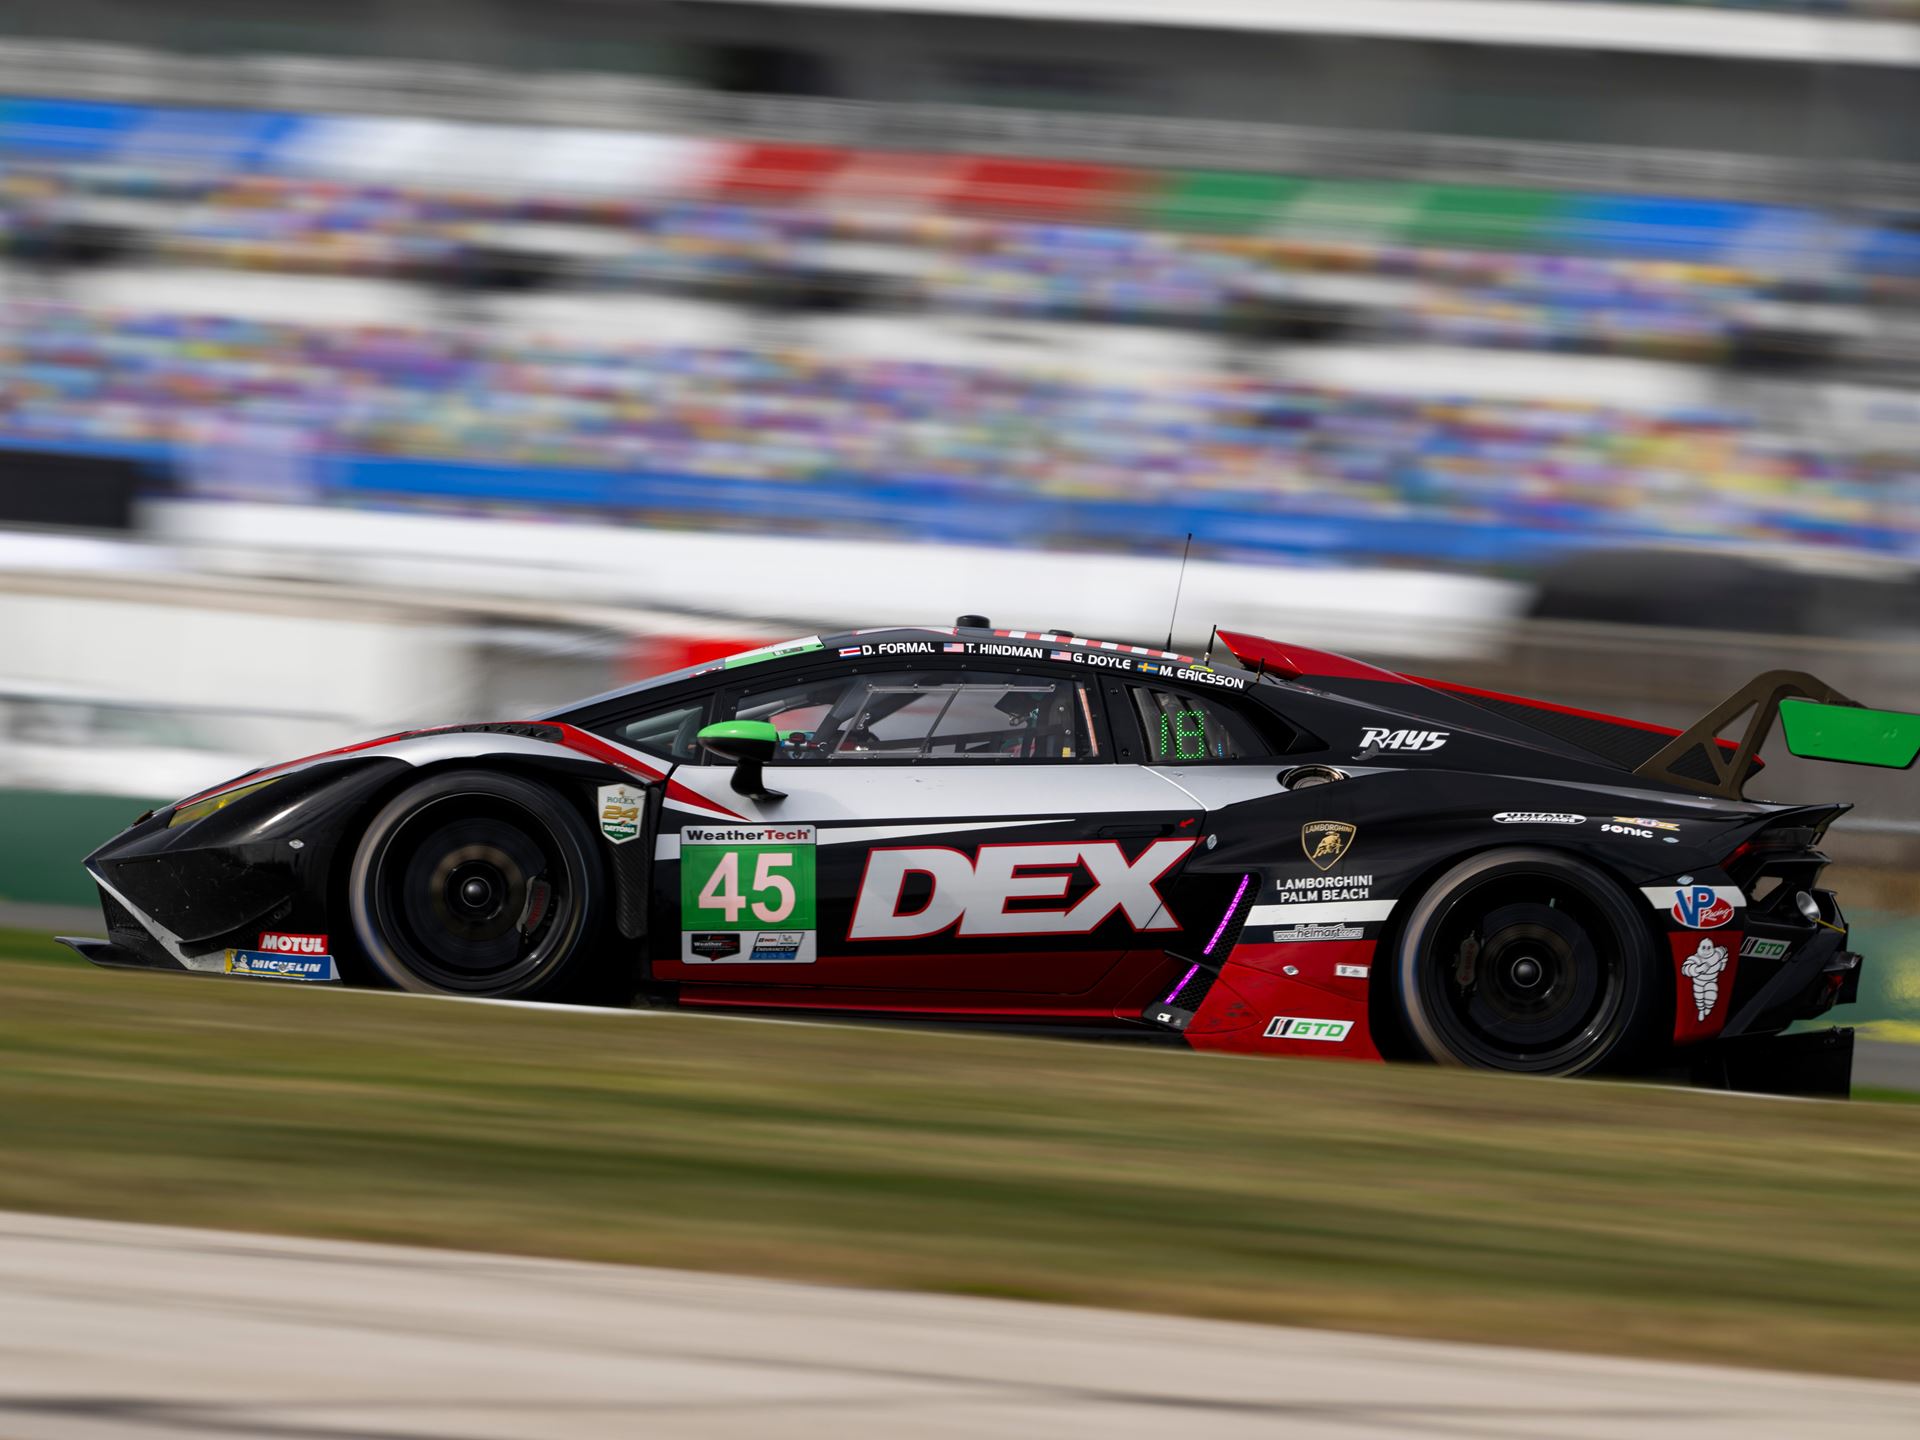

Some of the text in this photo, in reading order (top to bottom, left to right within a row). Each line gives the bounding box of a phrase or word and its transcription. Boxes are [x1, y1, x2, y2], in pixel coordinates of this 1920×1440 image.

[862, 642, 936, 656] D. FORMAL
[966, 643, 1043, 659] T. HINDMAN
[1072, 652, 1132, 670] G. DOYLE
[1159, 665, 1245, 689] M. ERICSSON
[1358, 726, 1451, 751] RAYS
[602, 805, 640, 822] 24
[1305, 823, 1353, 834] LAMBORGHINI
[698, 852, 796, 923] 45
[846, 836, 1206, 942] DEX
[1276, 875, 1373, 891] LAMBORGHINI
[1280, 888, 1369, 903] PALM BEACH
[1674, 885, 1717, 928] VP
[1700, 907, 1732, 922] Racing
[261, 934, 325, 953] MOTUL
[1754, 942, 1785, 956] GTD
[251, 959, 322, 973] MICELIN
[1292, 1021, 1345, 1037] GTD
